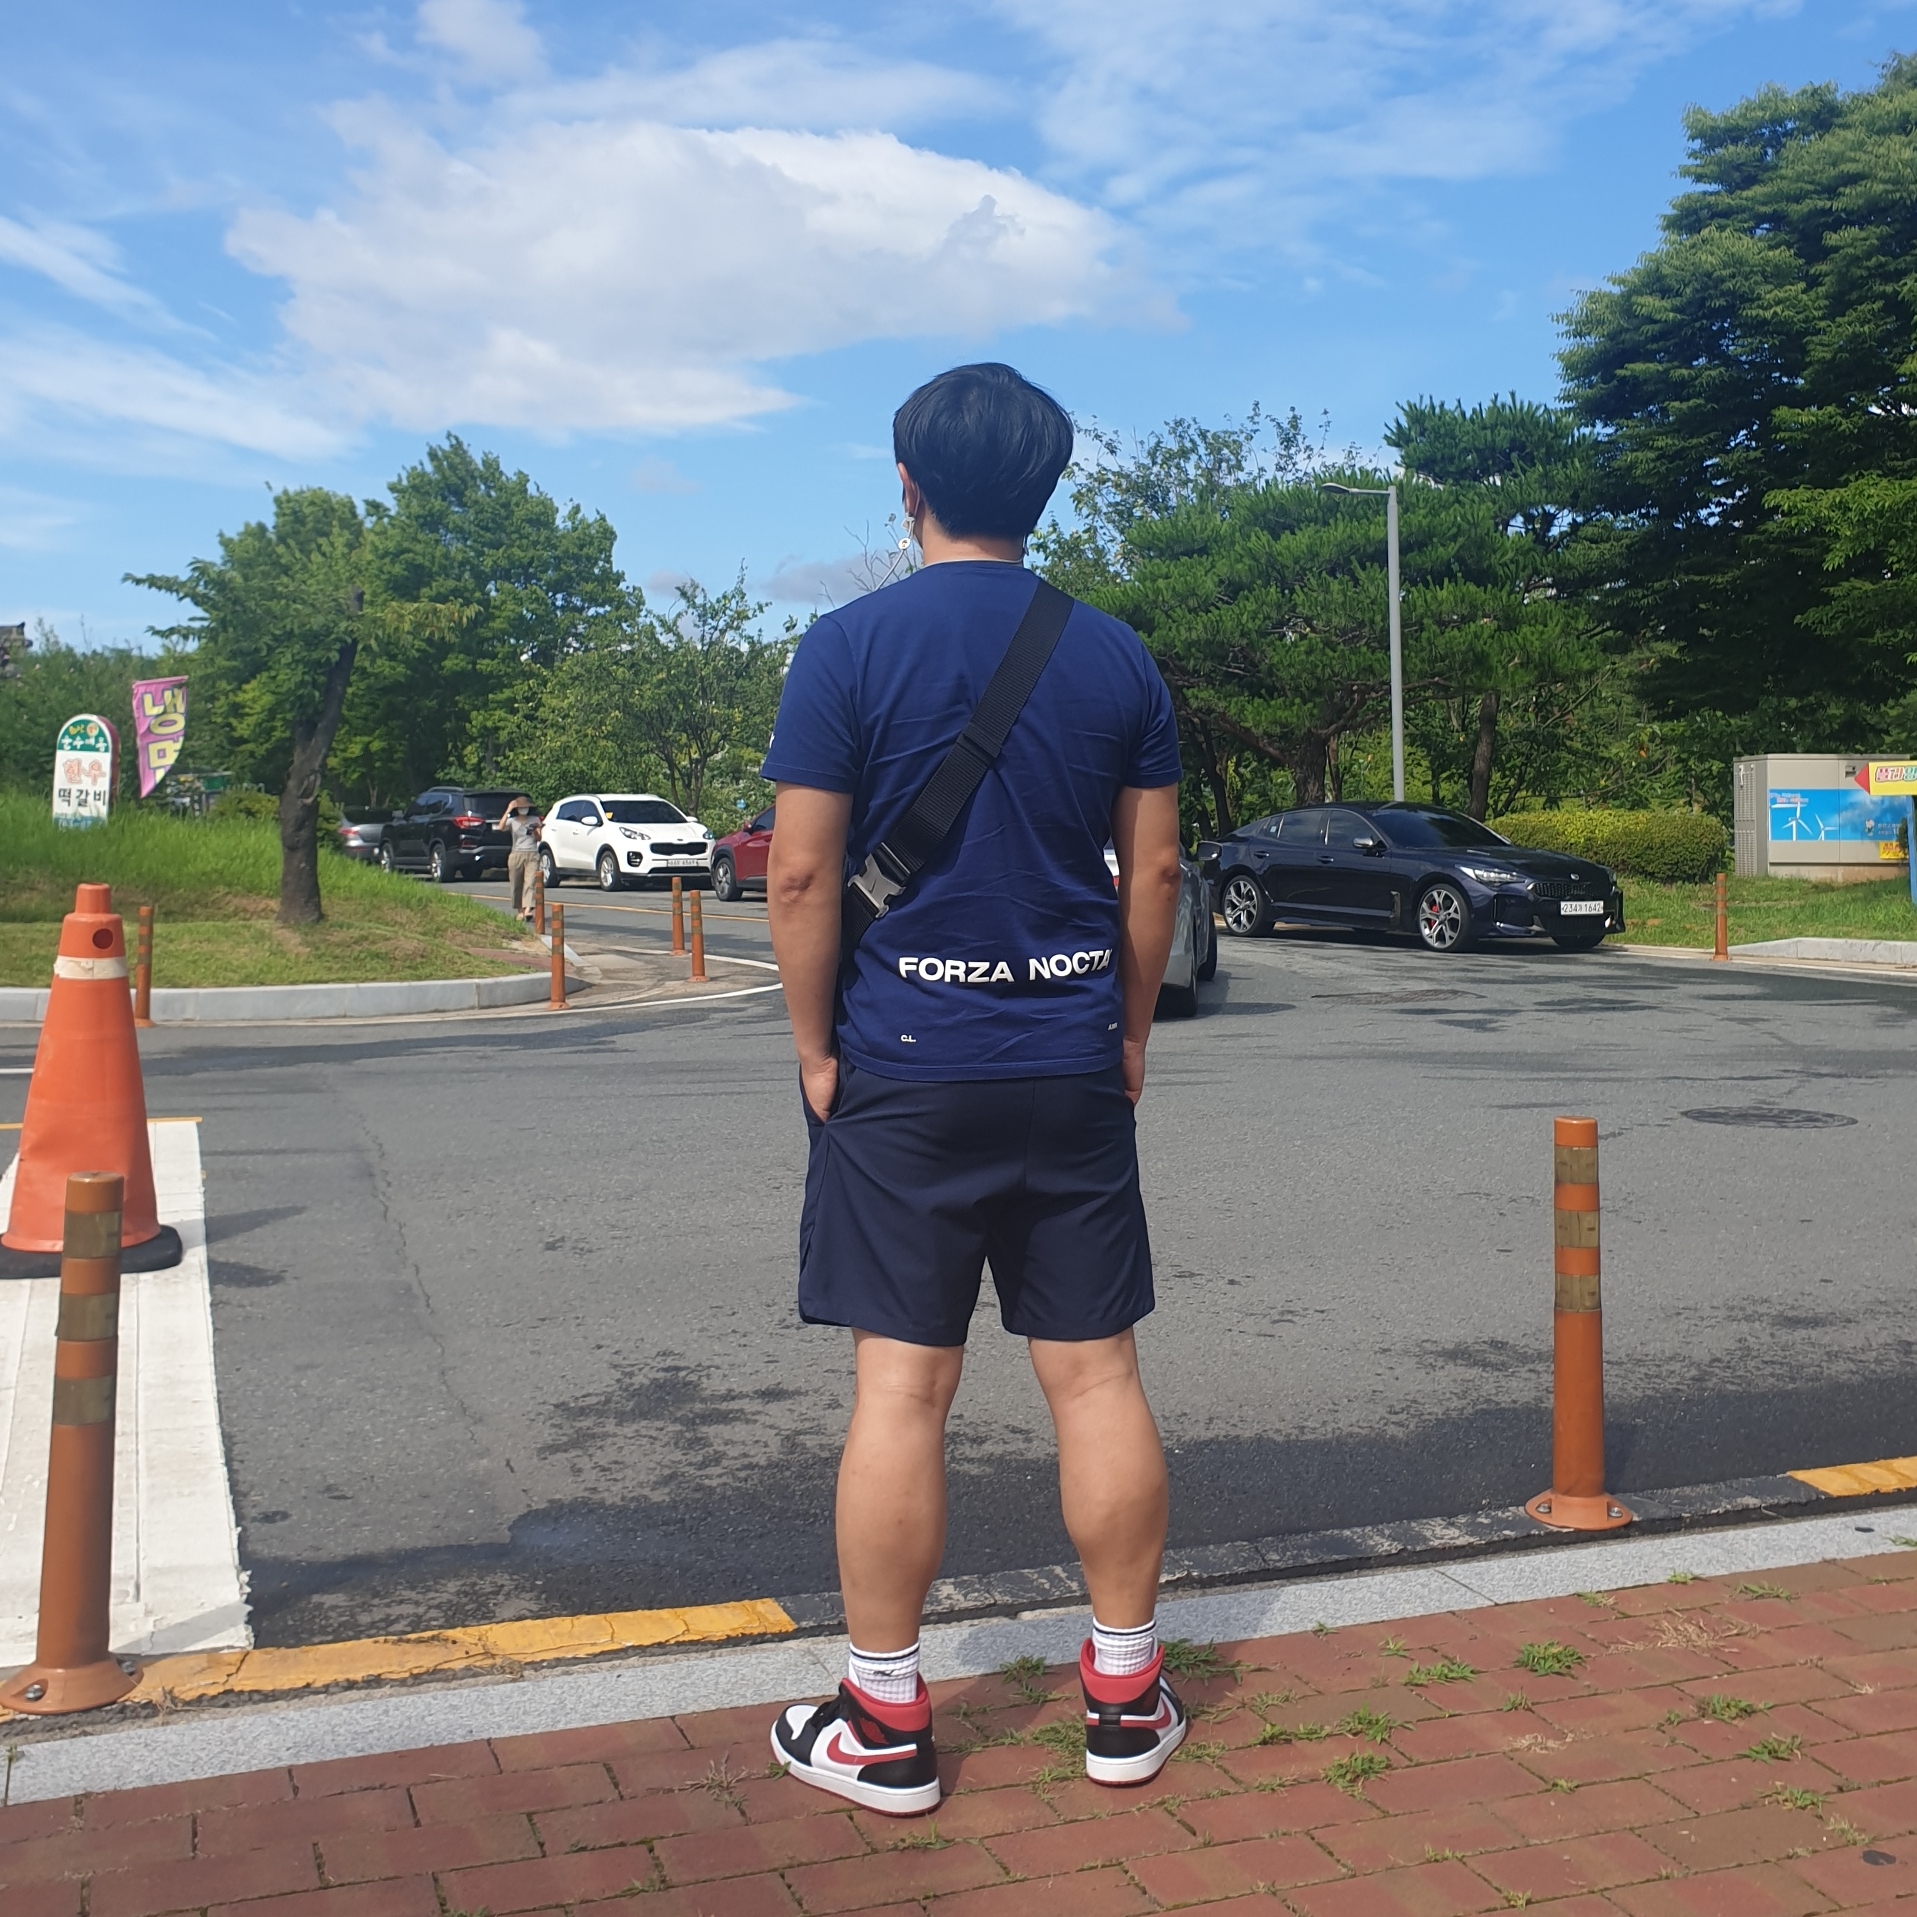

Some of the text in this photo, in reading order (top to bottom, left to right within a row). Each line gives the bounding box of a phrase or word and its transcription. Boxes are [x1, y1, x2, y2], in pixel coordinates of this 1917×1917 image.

[63, 758, 107, 786] 한우
[58, 788, 107, 808] 떡갈비
[899, 949, 1111, 983] FORZA NOCTA
